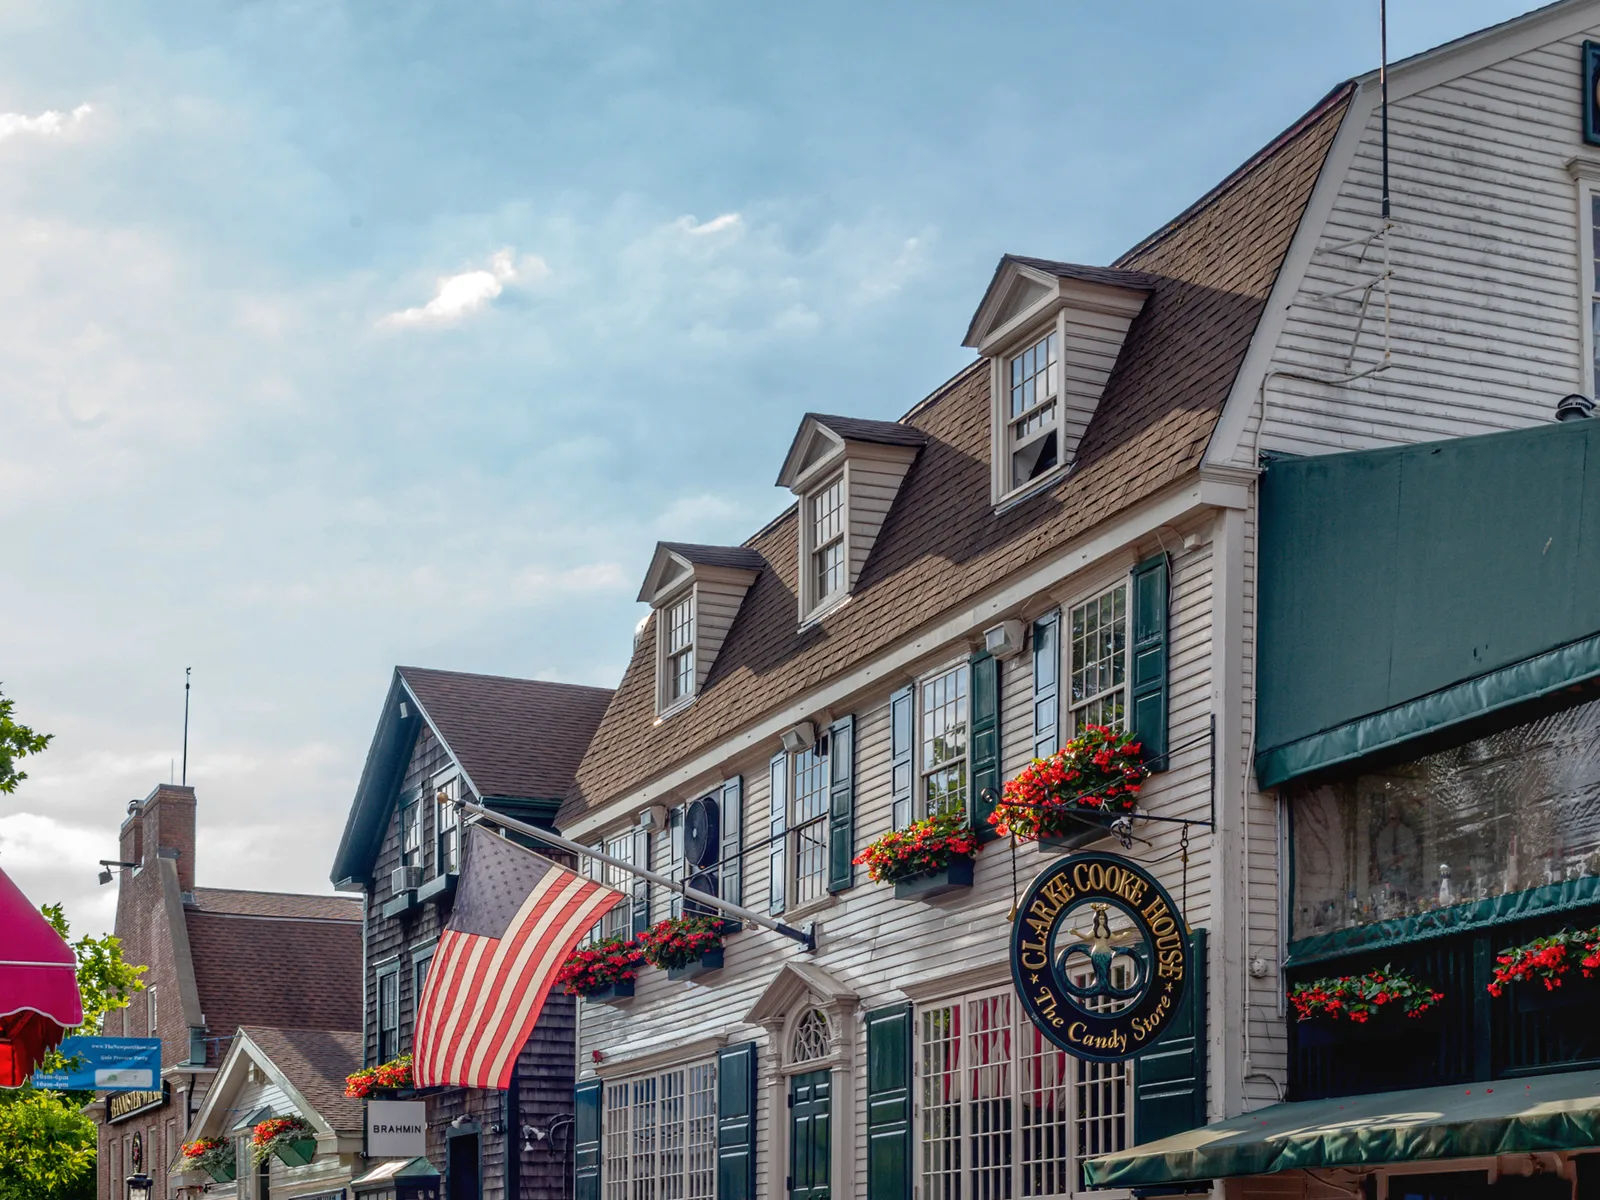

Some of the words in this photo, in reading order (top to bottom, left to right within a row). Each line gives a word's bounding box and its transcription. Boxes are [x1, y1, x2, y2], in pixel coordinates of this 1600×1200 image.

[1021, 871, 1076, 970] CLARKE
[1072, 863, 1149, 906] COOKE
[1142, 895, 1184, 981] HOUSE
[1034, 985, 1064, 1028] The
[1067, 1021, 1128, 1053] Candy
[1132, 994, 1172, 1041] Store
[373, 1124, 422, 1134] BRAHMIN
